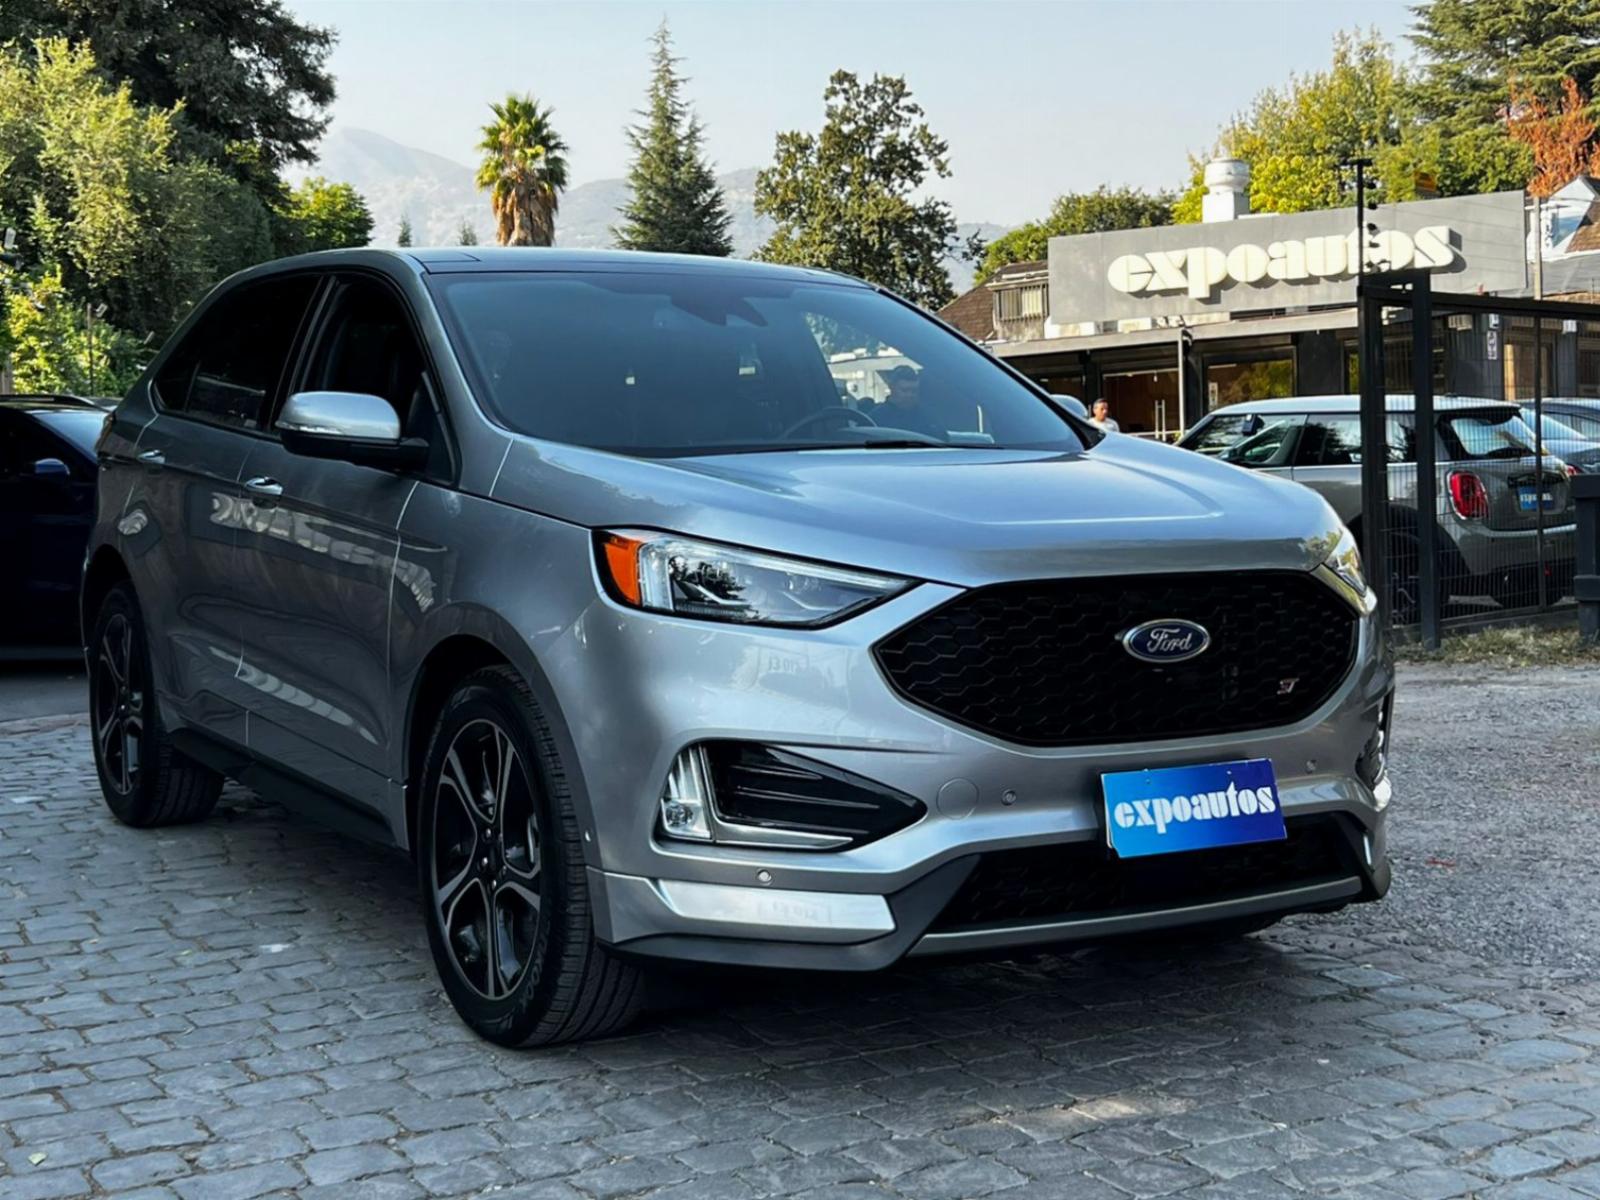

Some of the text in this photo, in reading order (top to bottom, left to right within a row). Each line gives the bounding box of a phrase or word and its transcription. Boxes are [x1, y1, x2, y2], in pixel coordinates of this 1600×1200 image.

[1107, 221, 1454, 299] expoautos
[1147, 627, 1192, 652] Ford
[1114, 781, 1276, 834] expoautos
